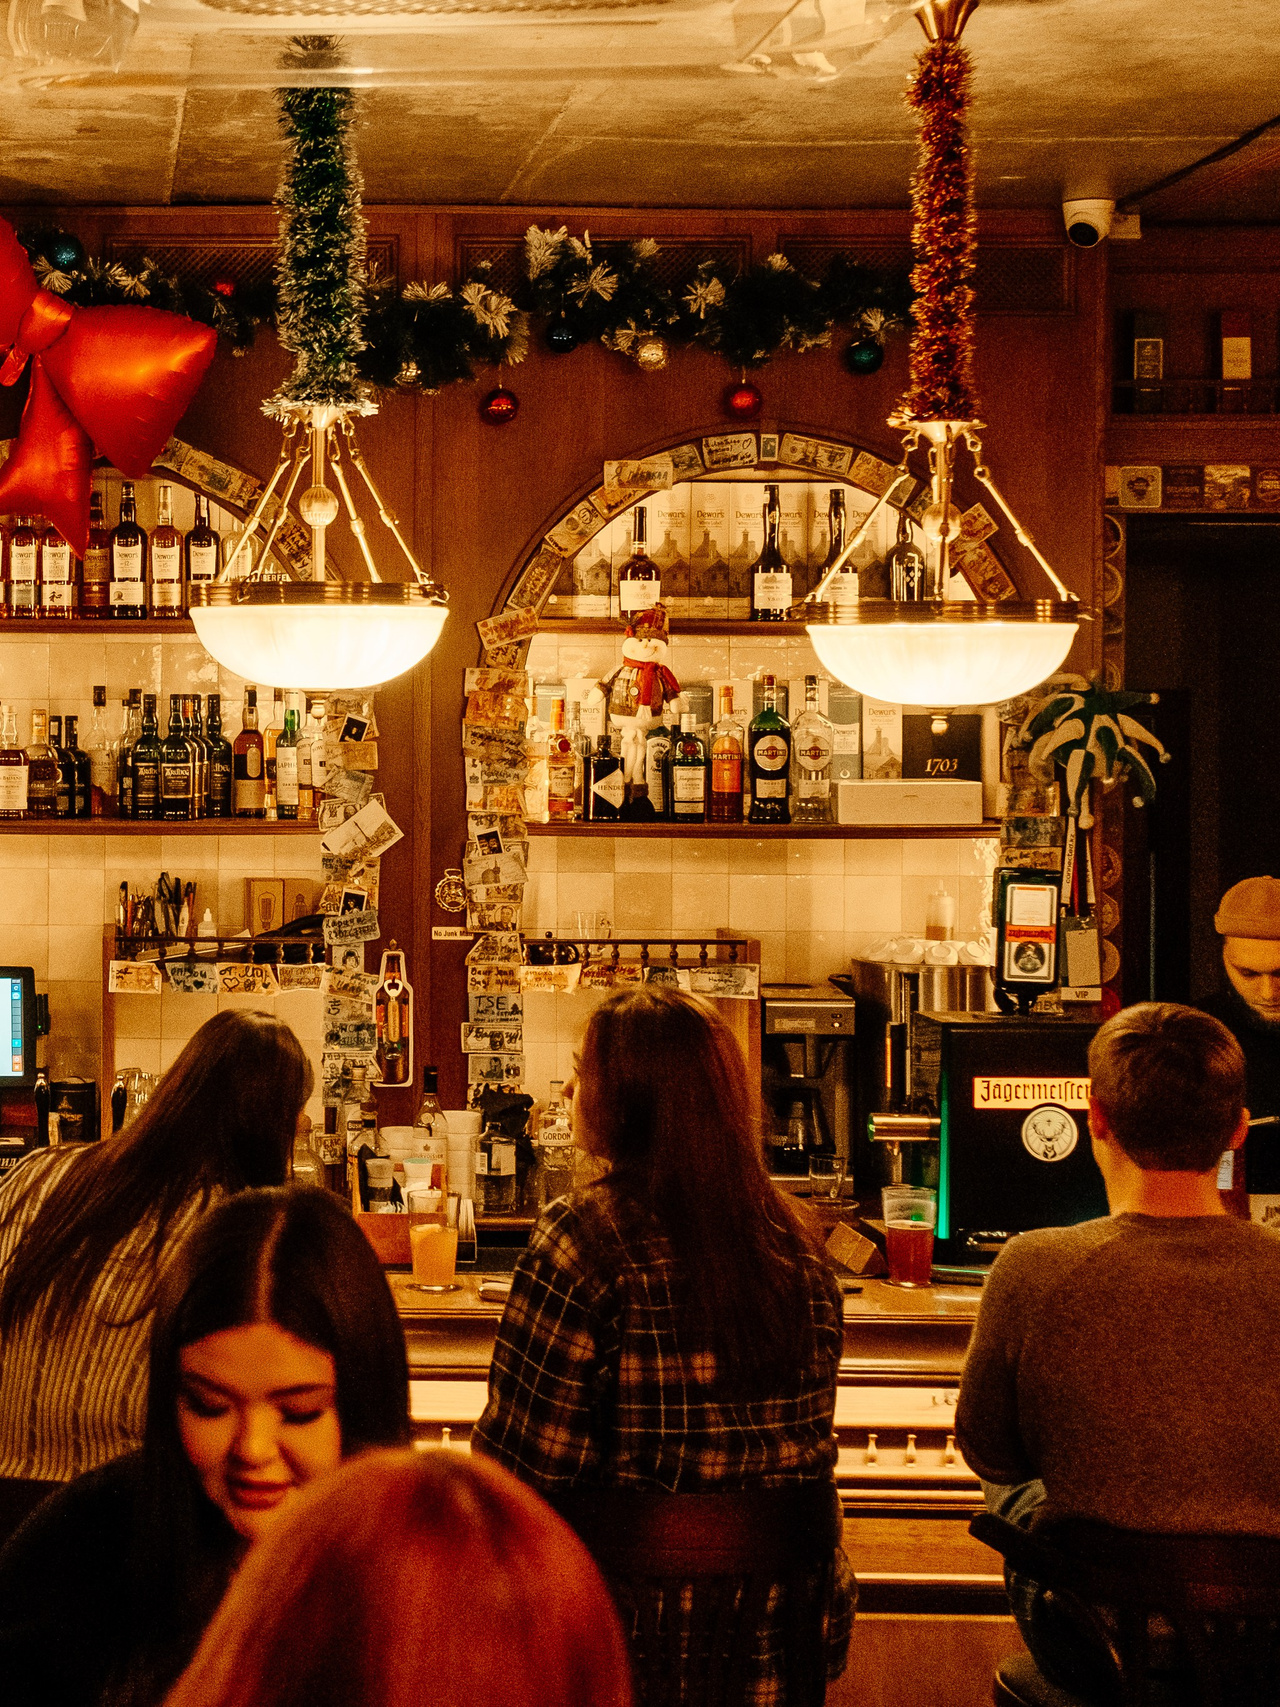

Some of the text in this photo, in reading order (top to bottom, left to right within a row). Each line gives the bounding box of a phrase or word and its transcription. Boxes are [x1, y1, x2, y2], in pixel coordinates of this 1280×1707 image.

[658, 510, 686, 518] Dewar's
[696, 510, 725, 518] Dewar's
[712, 752, 740, 761] MARTINI
[758, 749, 786, 757] MARTINI
[800, 750, 829, 758] MARTINI
[924, 758, 959, 777] 1703
[474, 995, 507, 1011] TSE
[543, 1131, 571, 1141] GORDON
